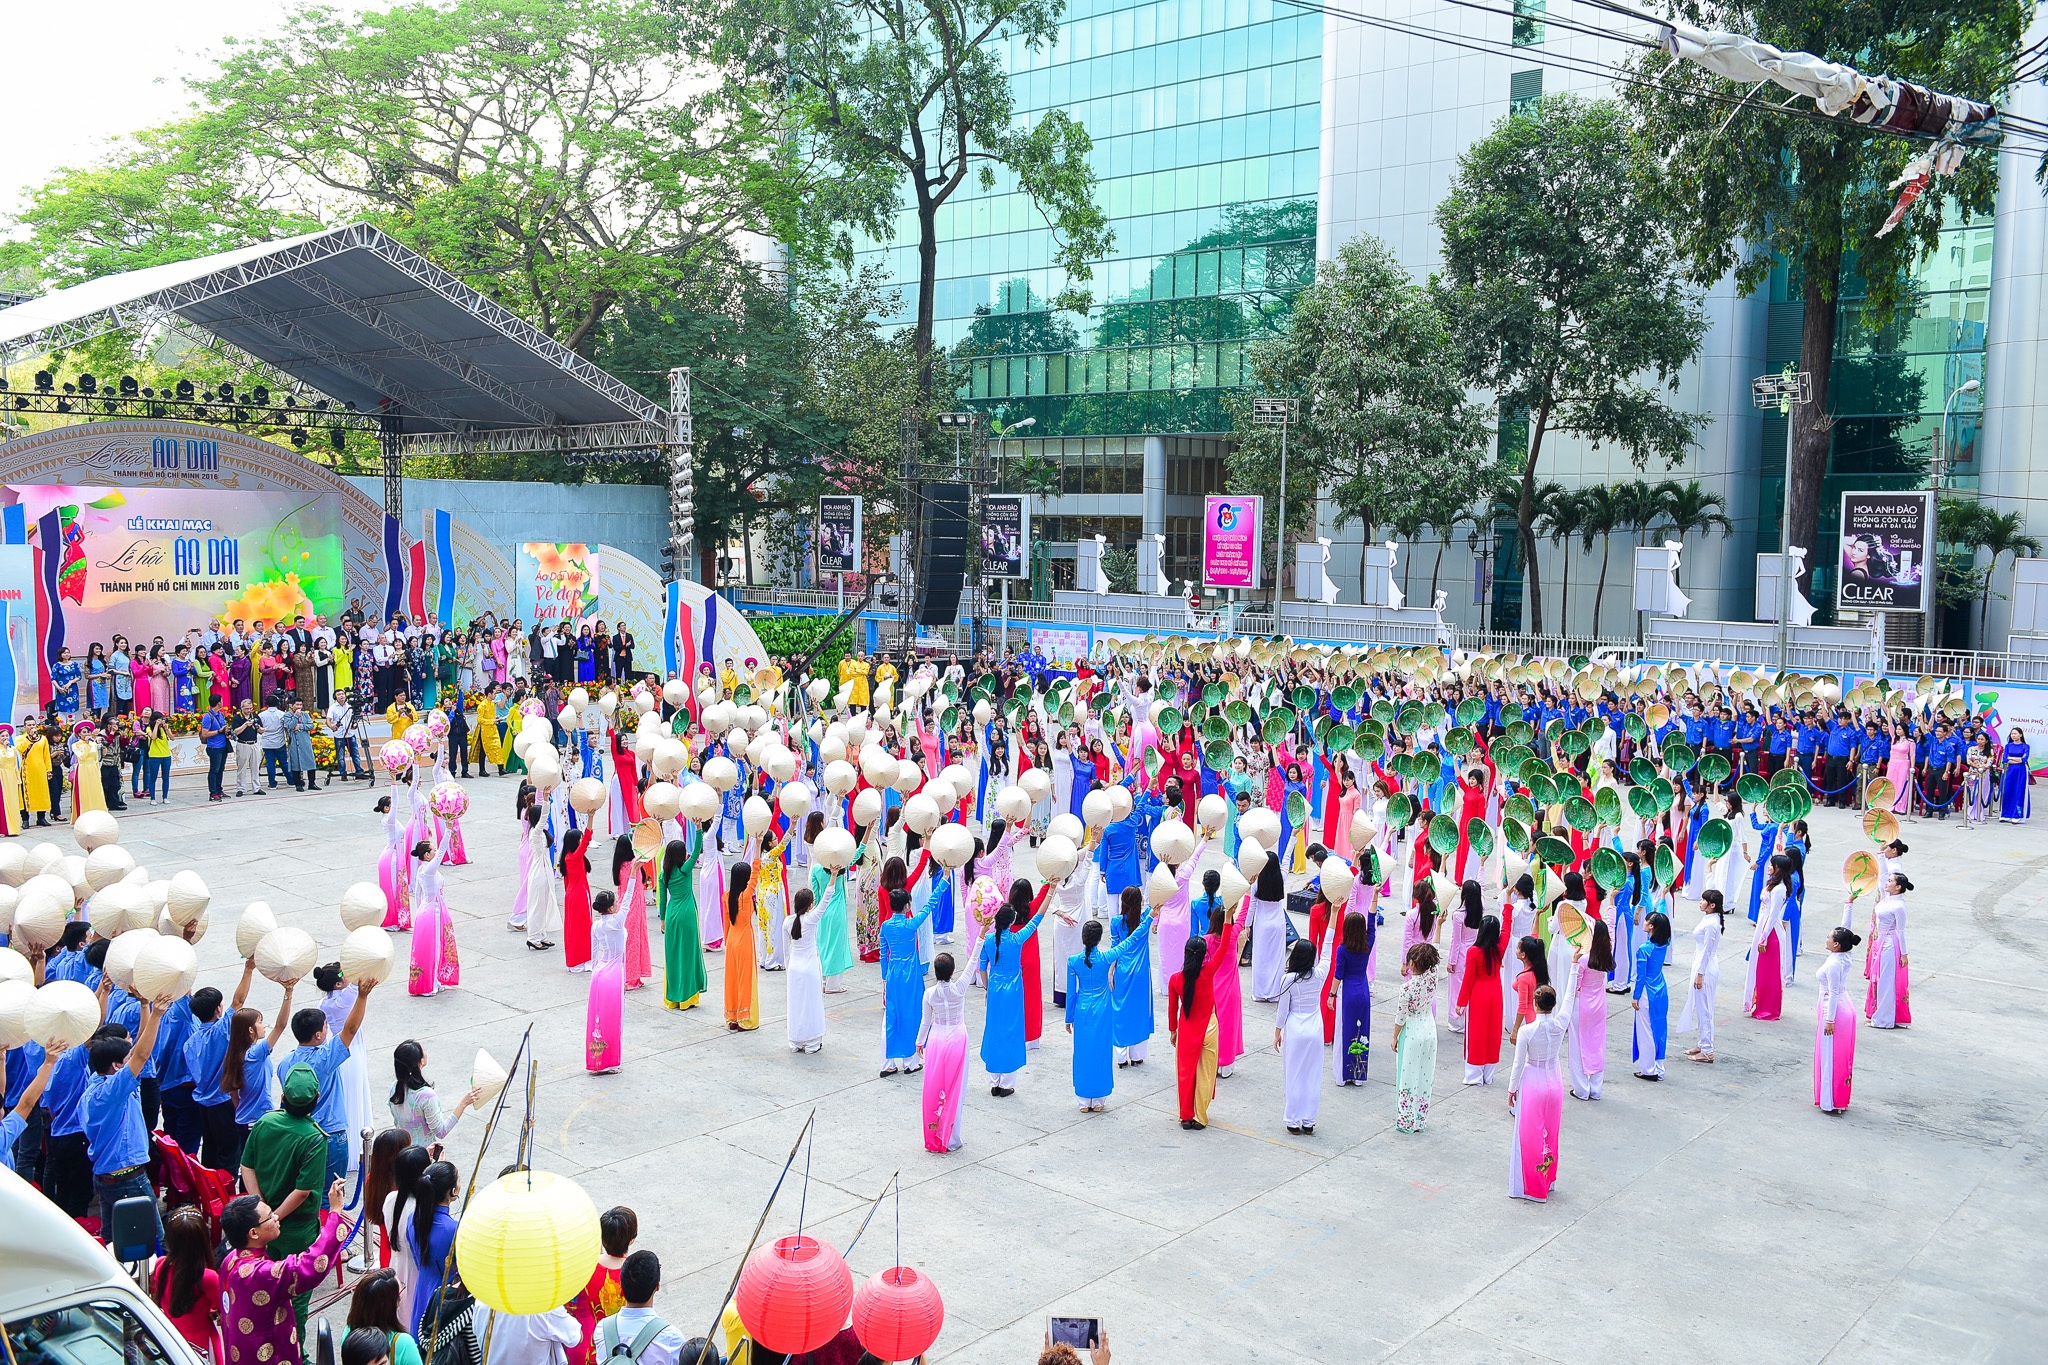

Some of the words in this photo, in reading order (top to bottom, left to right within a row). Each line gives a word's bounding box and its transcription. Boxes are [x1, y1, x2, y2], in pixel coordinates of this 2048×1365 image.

[112, 447, 149, 467] hội
[152, 436, 180, 470] ÁO
[186, 437, 219, 472] DÀI
[1853, 505, 1873, 514] HOA
[1874, 505, 1895, 514] ANH
[1896, 503, 1918, 514] ĐÀO
[146, 519, 180, 530] KHAI
[182, 519, 212, 533] MẠC
[95, 539, 150, 572] Lễ
[136, 546, 167, 568] hội
[174, 535, 201, 576] ÁO
[207, 535, 239, 576] DÀI
[821, 554, 843, 566] CLEAR
[982, 559, 1008, 571] CLEAR
[100, 580, 132, 592] THÀNH
[135, 579, 155, 592] PHỐ
[157, 579, 170, 592] HỒ
[172, 580, 188, 591] CHÍ
[191, 581, 215, 591] MINH
[217, 581, 240, 591] 2016
[1842, 583, 1894, 601] CLEAR
[535, 585, 553, 601] Vẻ
[556, 585, 582, 605] đẹp
[534, 603, 557, 619] bất
